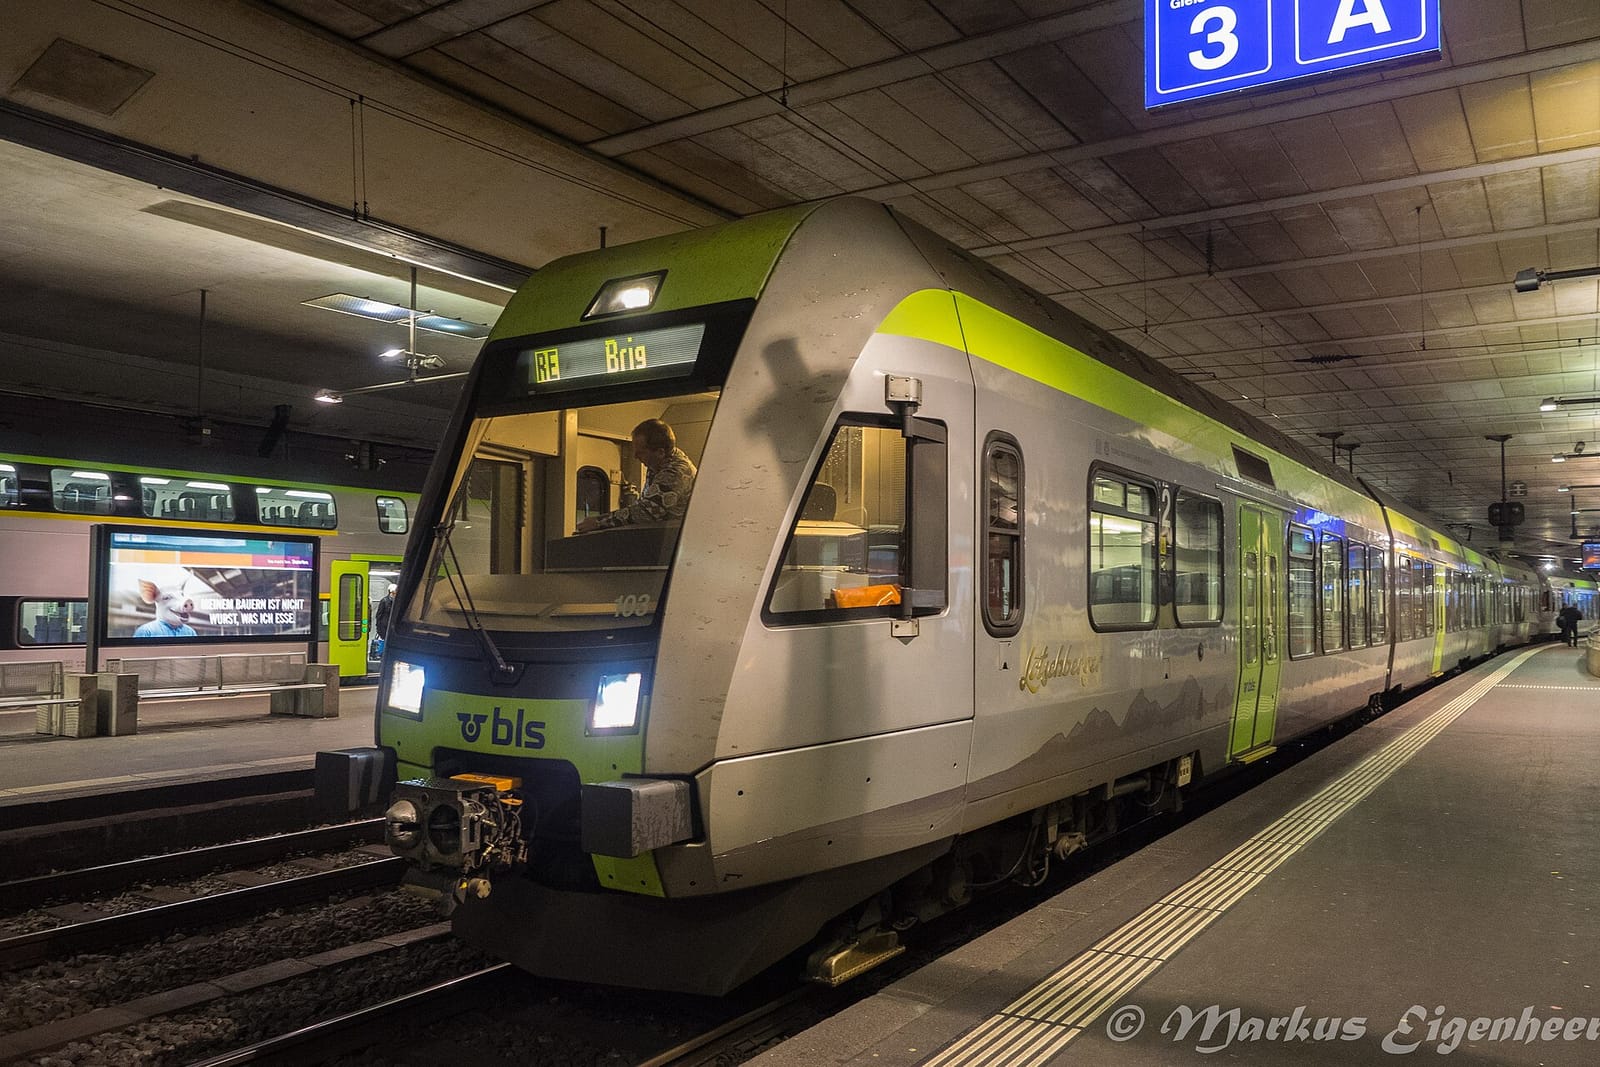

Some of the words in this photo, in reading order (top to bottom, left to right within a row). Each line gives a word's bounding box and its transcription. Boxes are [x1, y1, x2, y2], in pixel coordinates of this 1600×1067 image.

[1188, 5, 1239, 71] 3
[1326, 0, 1392, 45] A
[536, 351, 559, 380] RE
[605, 336, 647, 374] Brig
[209, 612, 239, 626] WURST,
[240, 612, 258, 625] WAS
[259, 612, 274, 625] ICH
[235, 598, 267, 610] BAUERN
[267, 598, 280, 610] IST
[281, 598, 305, 610] NICHT
[614, 593, 651, 618] 103
[491, 706, 546, 750] bls
